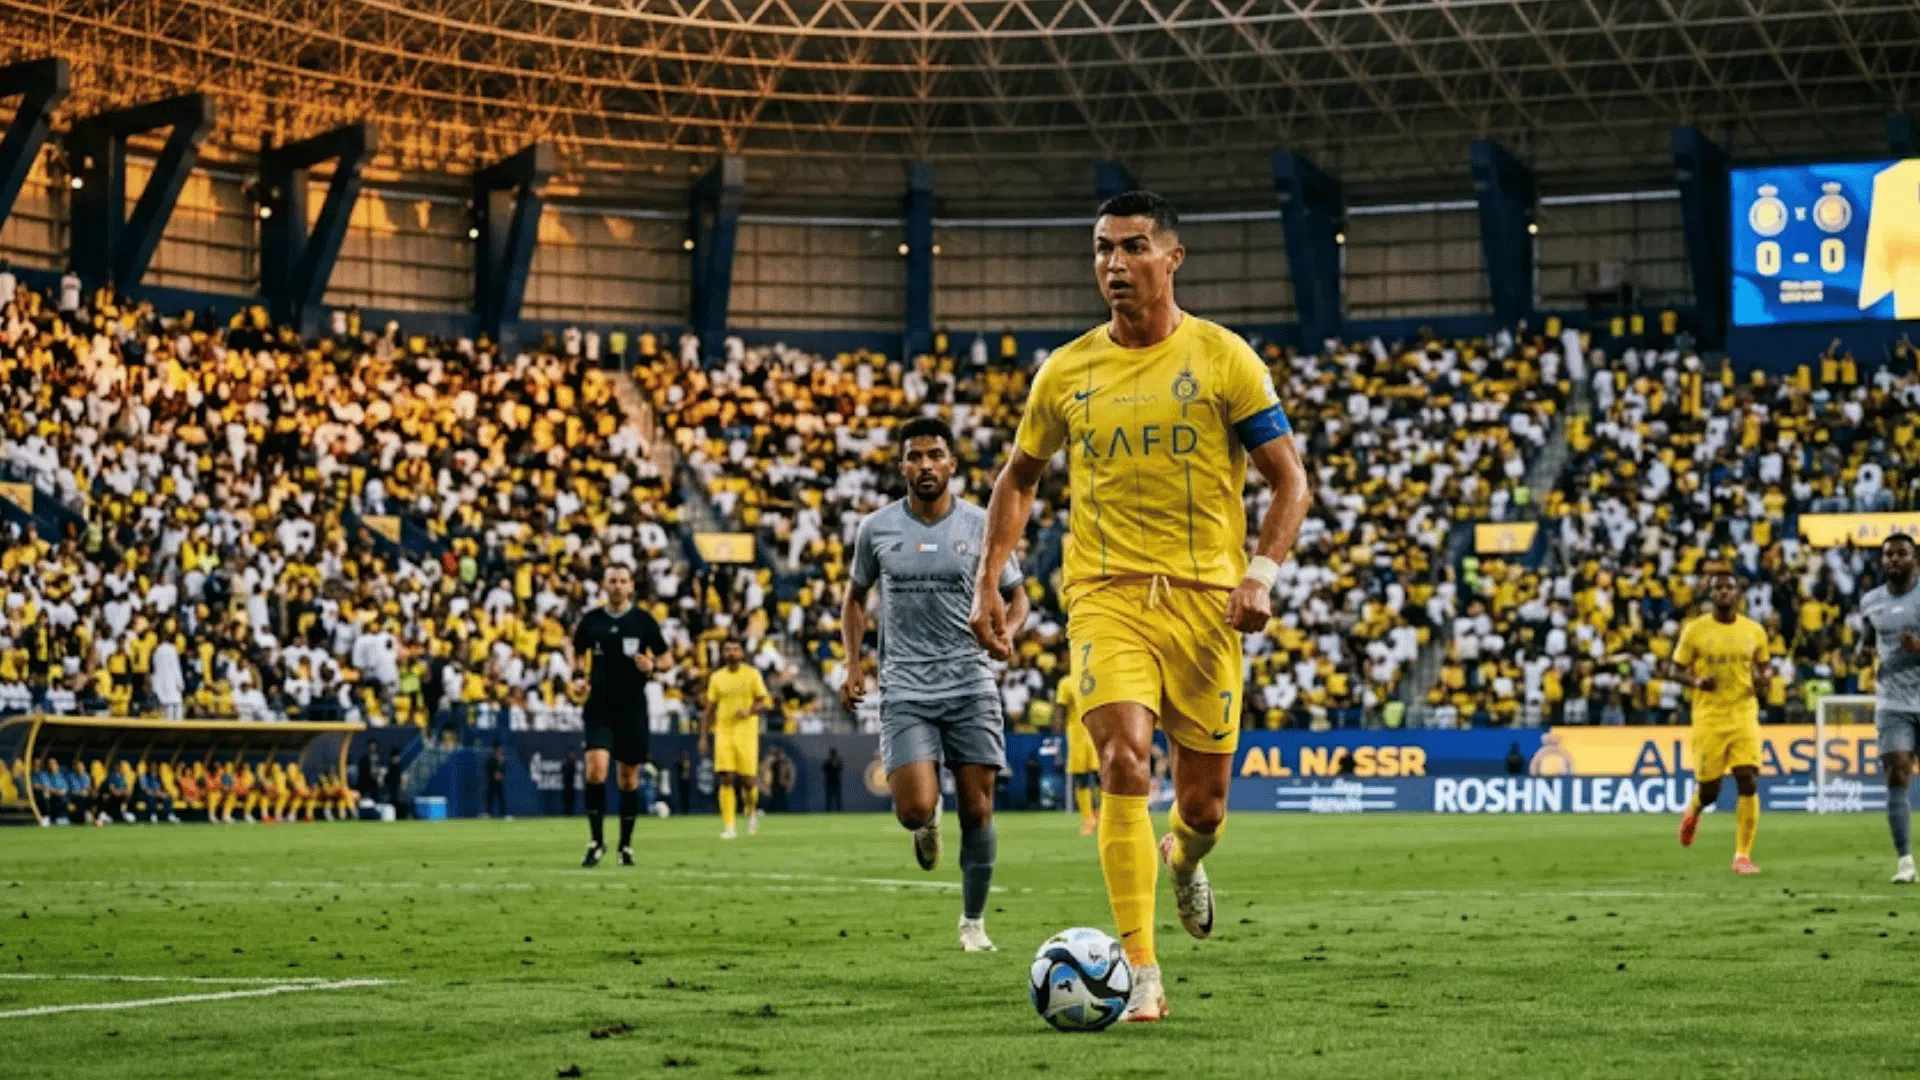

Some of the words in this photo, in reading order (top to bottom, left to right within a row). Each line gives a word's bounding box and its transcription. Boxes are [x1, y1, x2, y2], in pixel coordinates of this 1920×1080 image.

[1756, 240, 1782, 276] 0
[1820, 238, 1845, 273] 0
[1080, 424, 1198, 459] KAFD
[1219, 691, 1232, 724] 7
[1241, 746, 1292, 777] AL
[1633, 739, 1695, 777] AL
[1434, 777, 1562, 813] ROSHN
[1573, 777, 1717, 813] LEAGU
